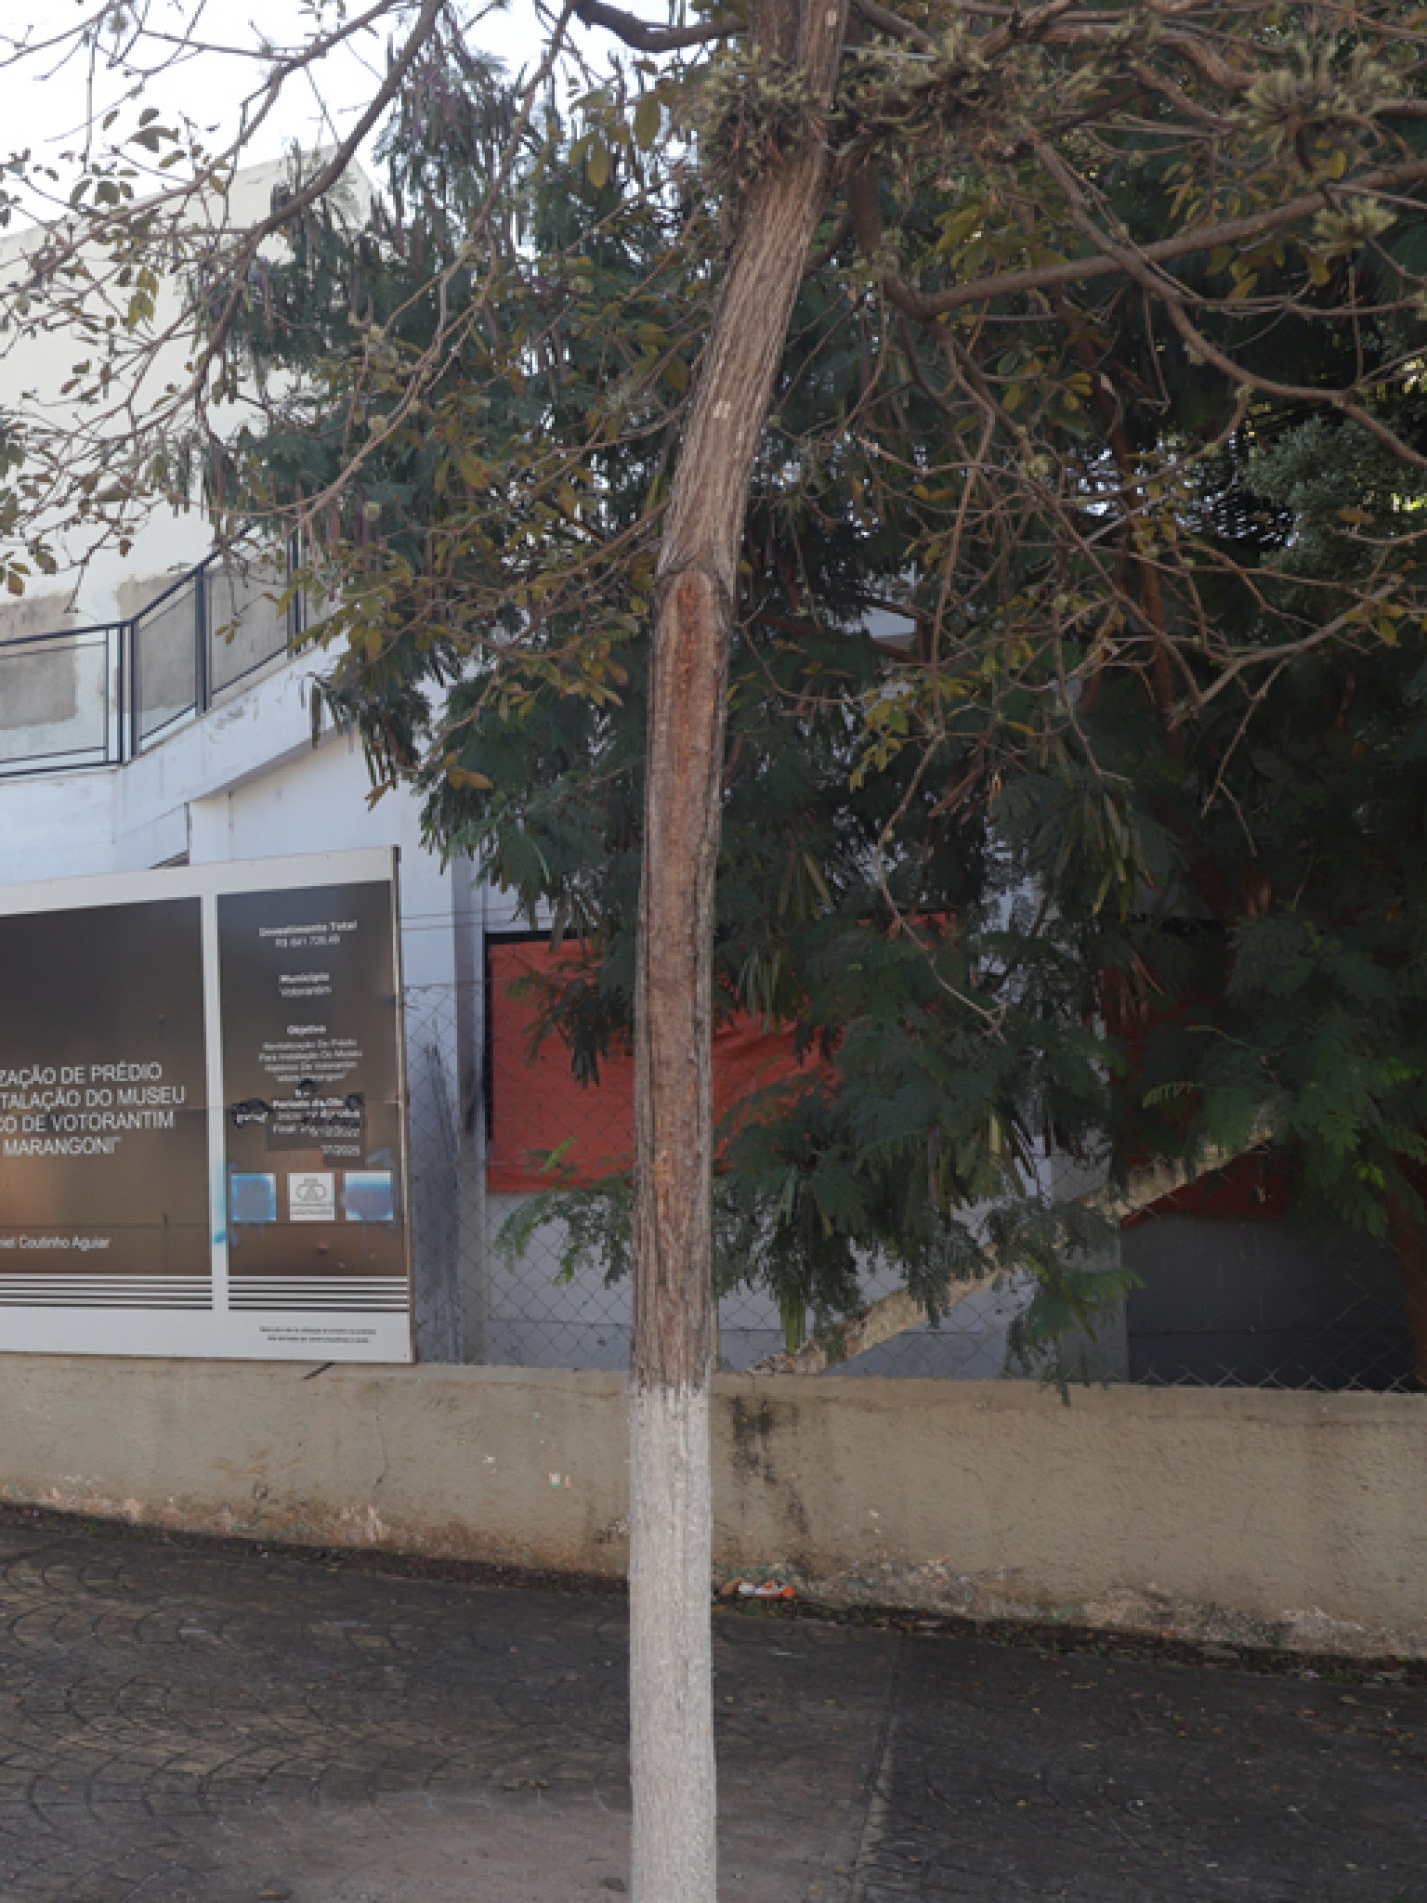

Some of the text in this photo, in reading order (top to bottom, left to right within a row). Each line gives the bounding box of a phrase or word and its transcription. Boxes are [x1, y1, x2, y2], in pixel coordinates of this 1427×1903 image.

[60, 1066, 87, 1085] DE
[91, 1060, 163, 1082] PRÉDIO
[85, 1088, 113, 1107] DO
[117, 1086, 186, 1105] MUSEU
[21, 1113, 46, 1132] DE
[50, 1110, 176, 1132] VOTORANTIM
[18, 1234, 70, 1249] Coutinho
[71, 1234, 111, 1252] Aguiar
